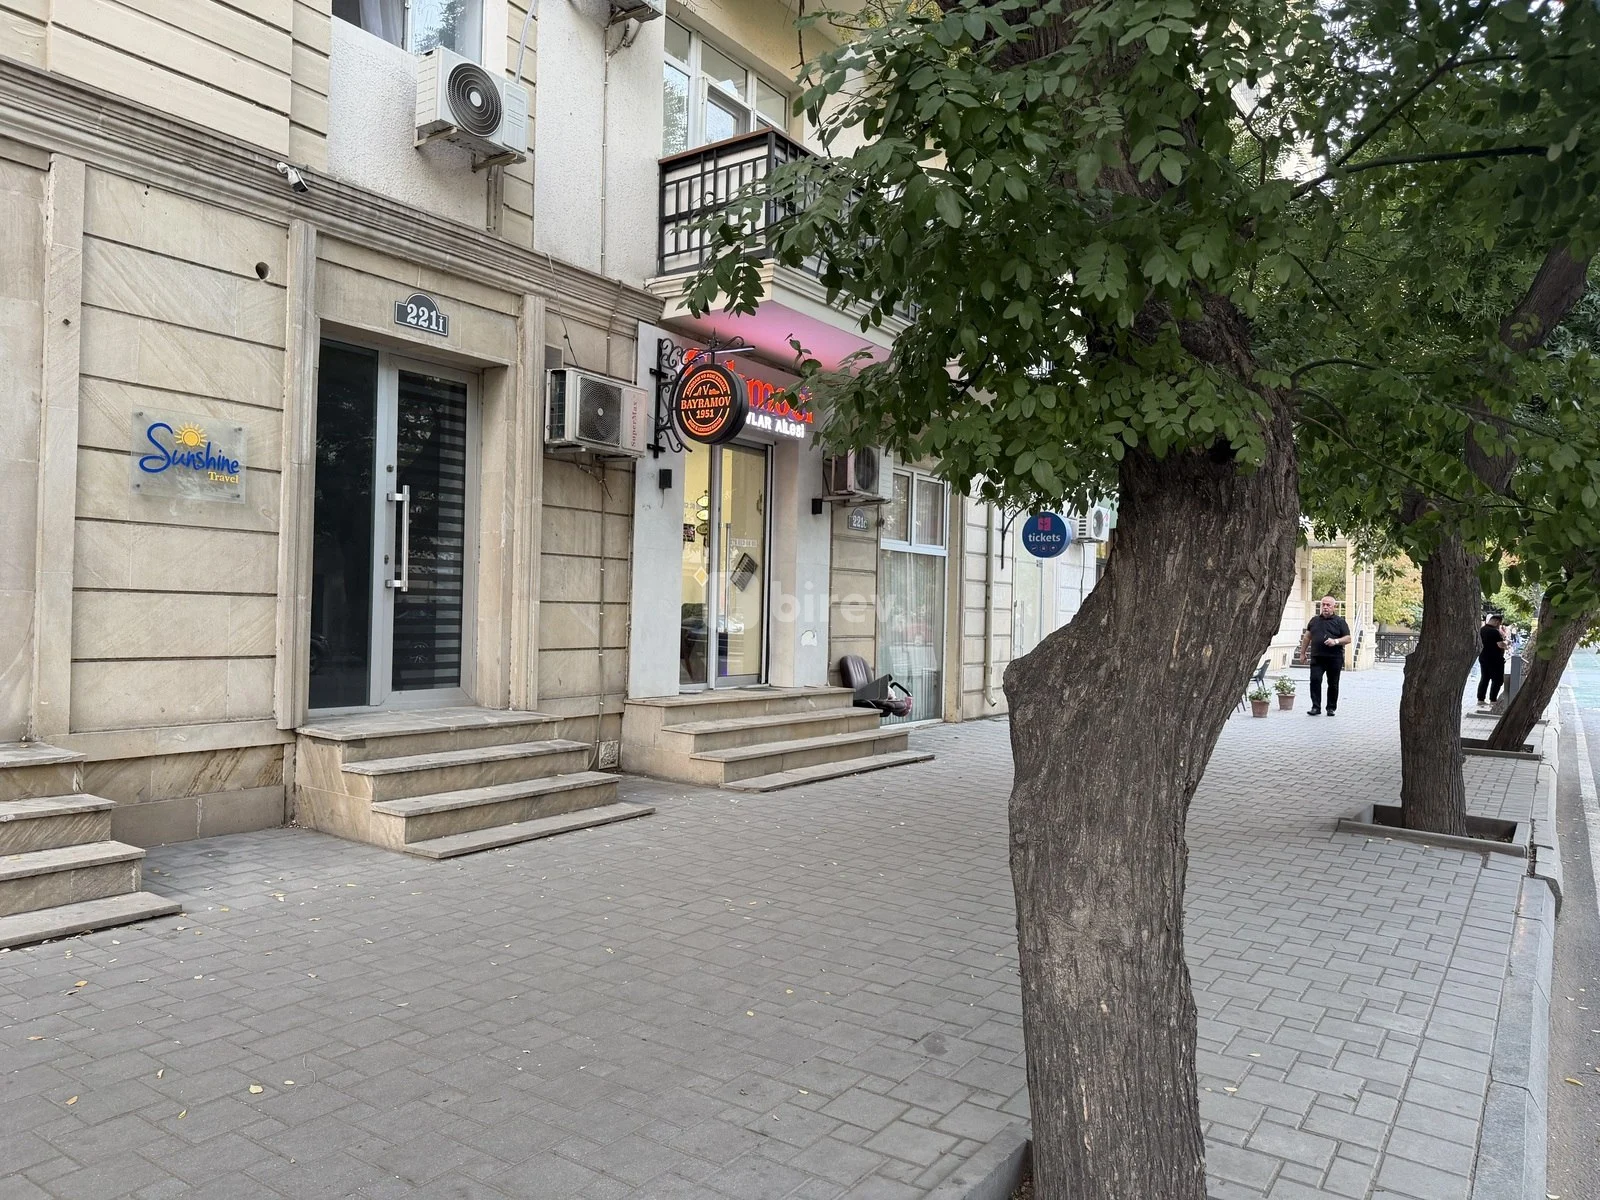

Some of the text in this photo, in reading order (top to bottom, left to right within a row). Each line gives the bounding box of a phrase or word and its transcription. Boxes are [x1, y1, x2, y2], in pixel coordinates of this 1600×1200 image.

[680, 395, 732, 410] BAYRAMOV
[695, 409, 715, 419] 1951
[139, 422, 240, 475] Sunshine
[207, 471, 239, 484] Travel
[1028, 532, 1061, 542] tickets
